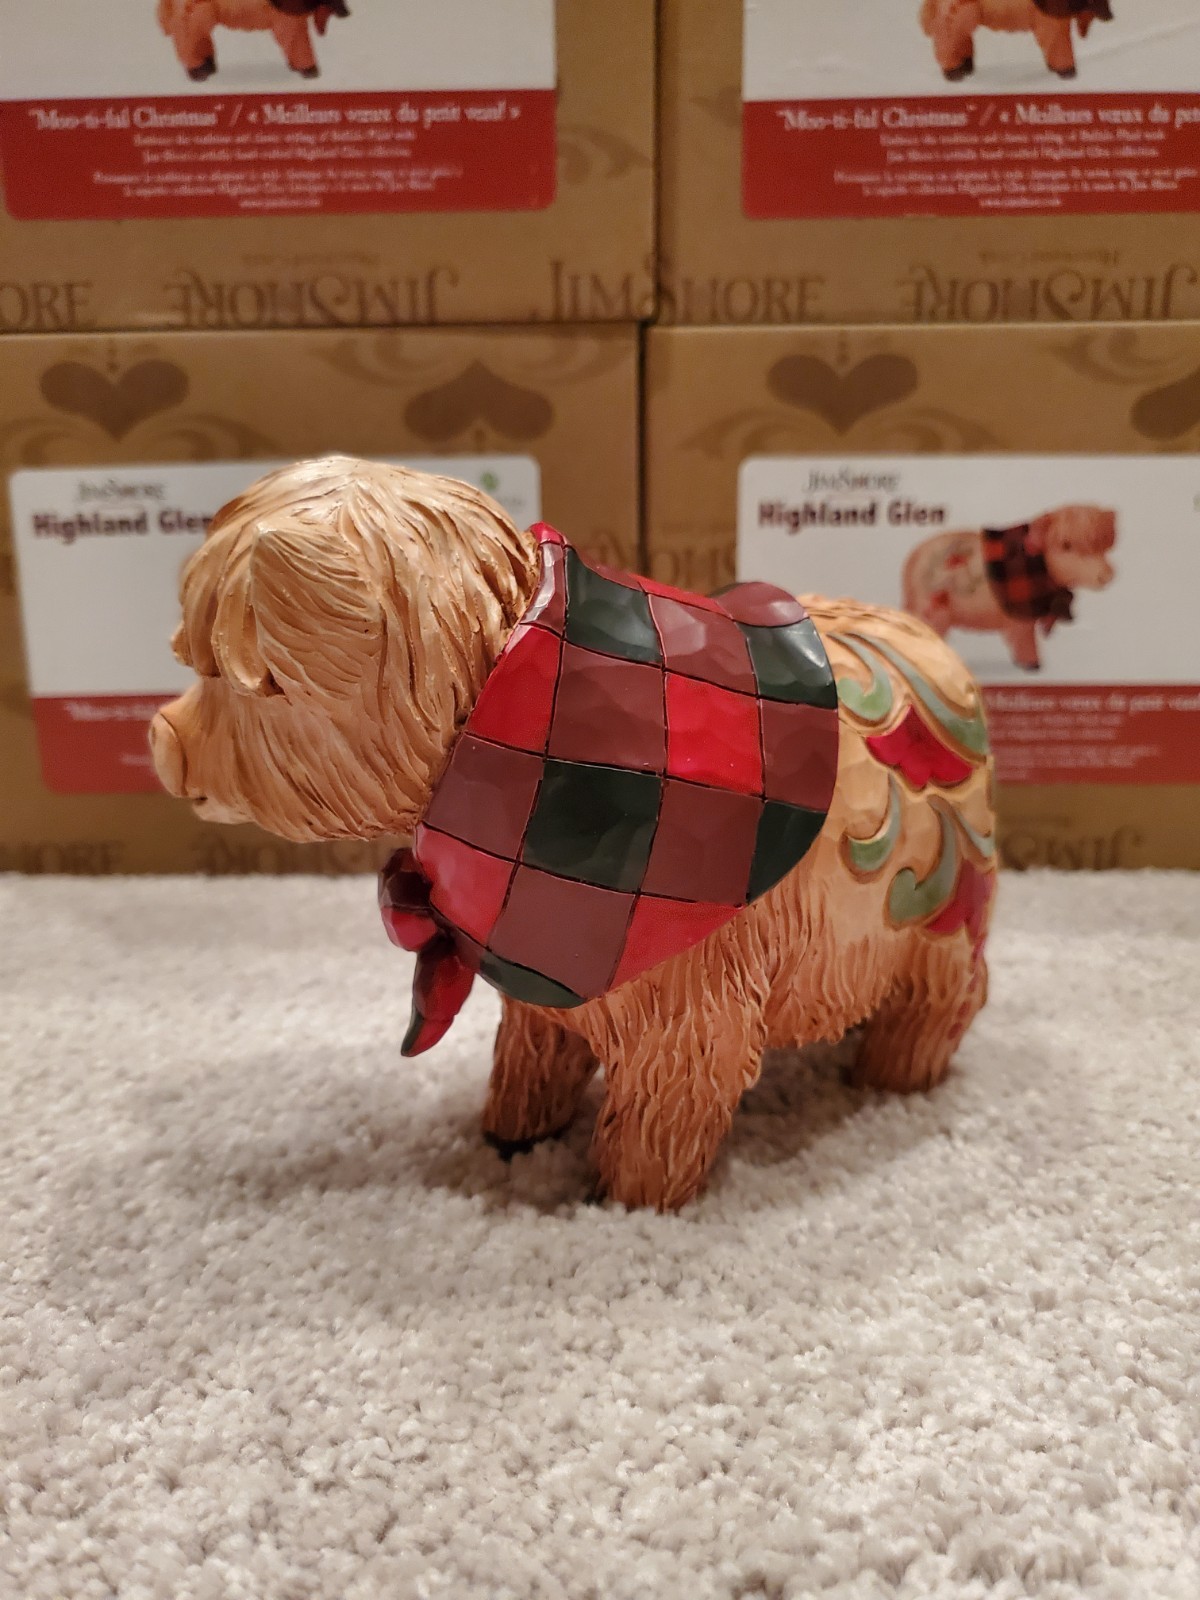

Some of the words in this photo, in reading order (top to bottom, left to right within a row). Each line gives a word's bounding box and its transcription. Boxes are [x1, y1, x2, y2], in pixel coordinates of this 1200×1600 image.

[33, 511, 148, 545] Highland
[759, 500, 877, 534] Highland
[888, 500, 946, 527] Glen
